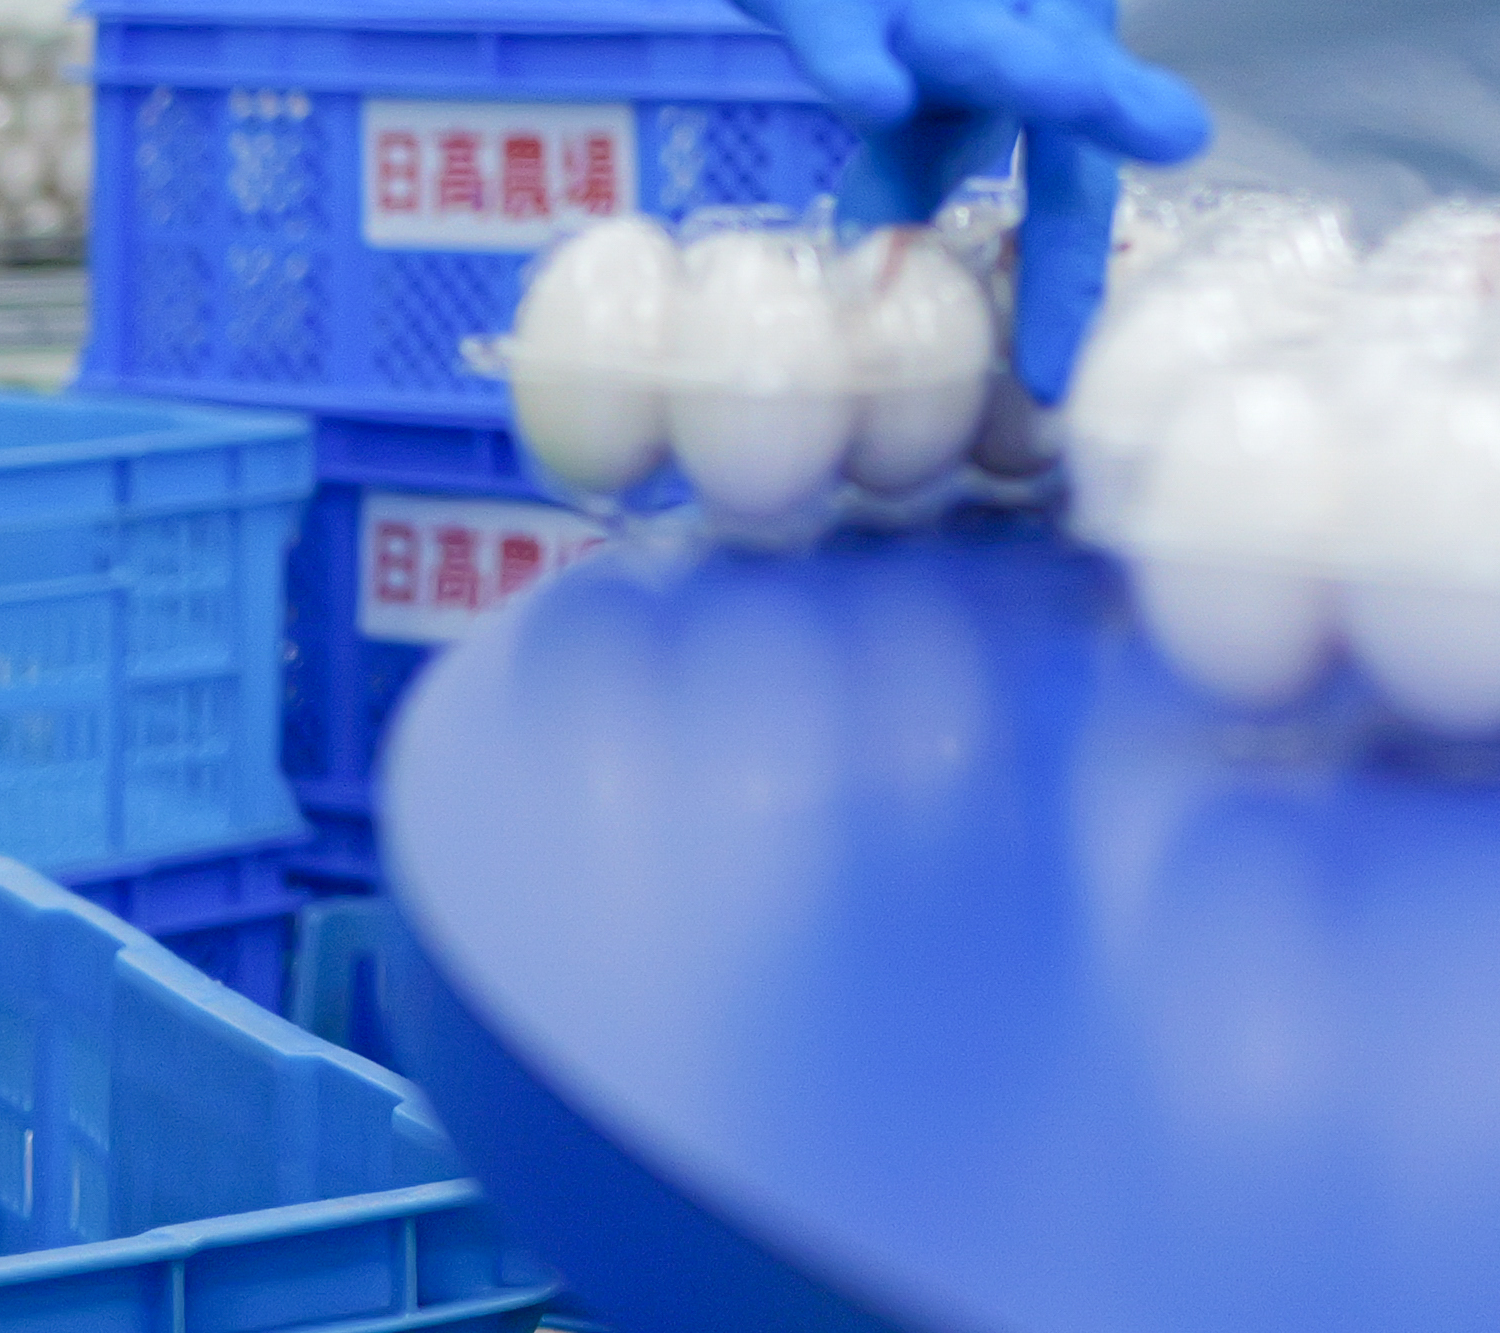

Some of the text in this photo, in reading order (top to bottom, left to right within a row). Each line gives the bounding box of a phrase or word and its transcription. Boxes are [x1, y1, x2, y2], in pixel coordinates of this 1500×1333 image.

[377, 131, 614, 215] 日高農場
[376, 521, 602, 610] 日高農
